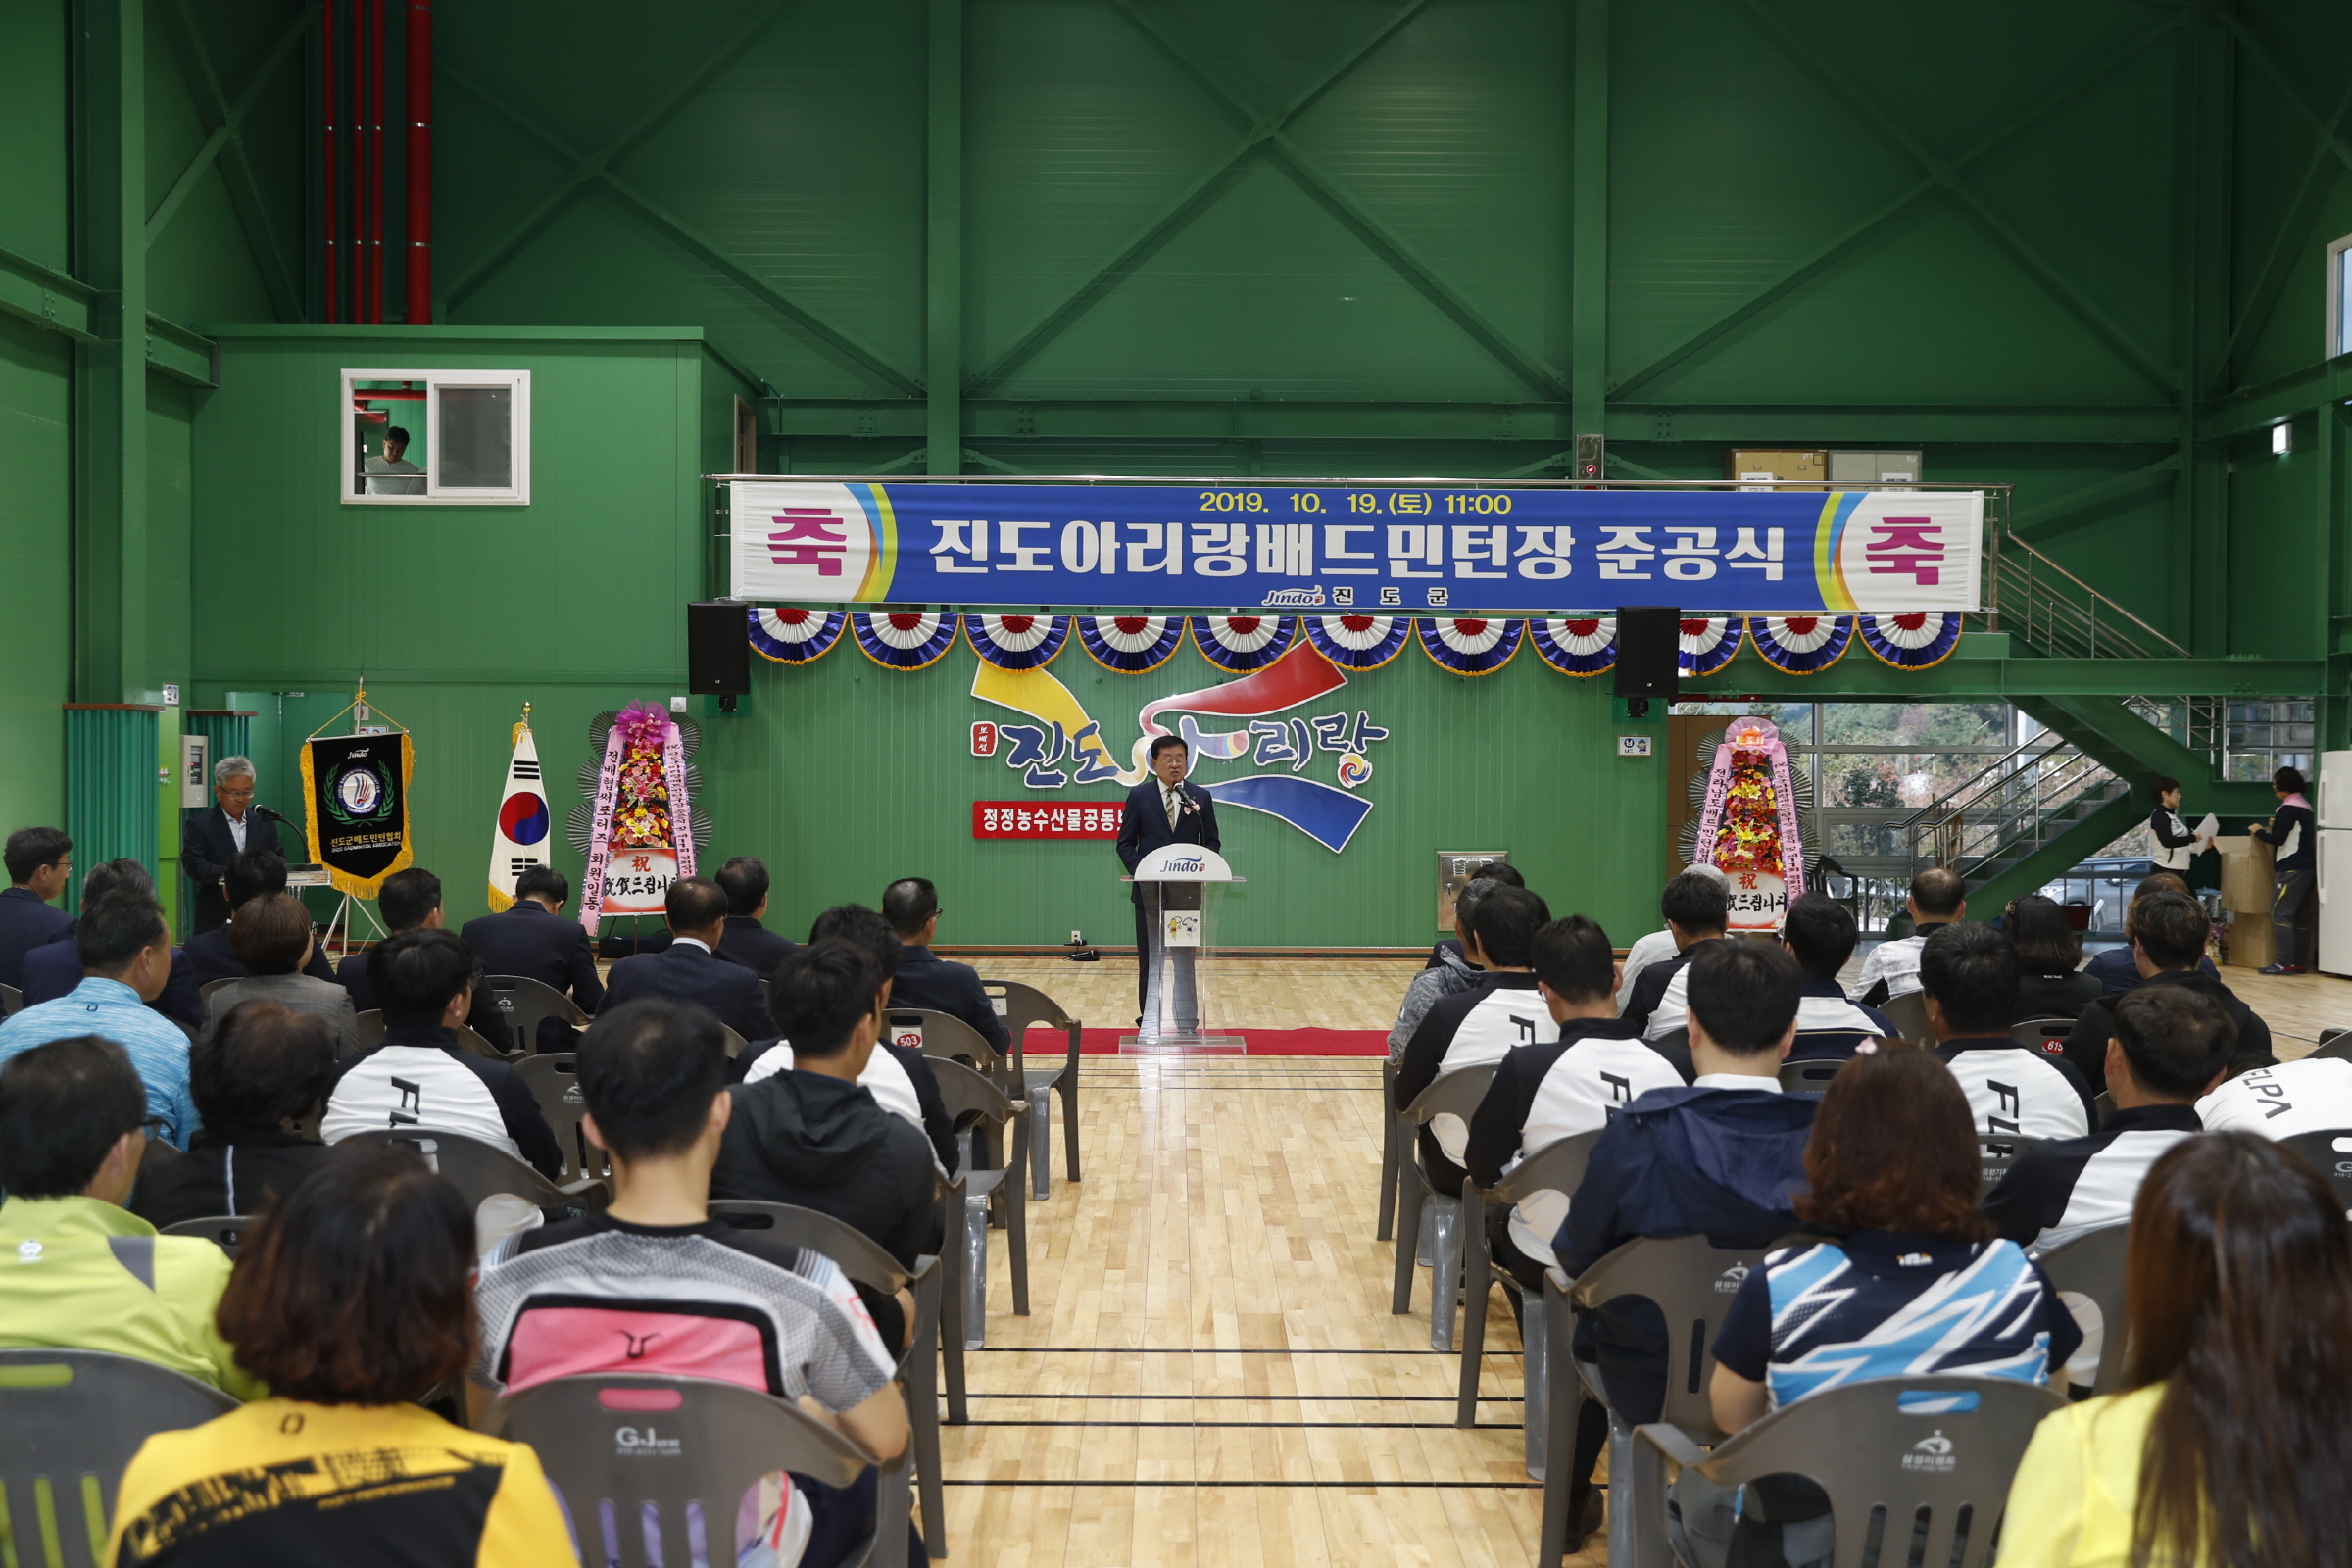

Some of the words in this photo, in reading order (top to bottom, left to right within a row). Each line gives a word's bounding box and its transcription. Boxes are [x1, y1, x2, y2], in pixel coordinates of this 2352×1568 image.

[1199, 491, 1269, 514] 2019.
[1290, 492, 1327, 514] 10.
[1445, 493, 1512, 514] 11:00
[767, 508, 847, 576] 축
[928, 520, 1575, 581] 진도아리랑배드민턴장
[1595, 525, 1785, 582] 준공식
[1865, 516, 1945, 586] 축
[348, 748, 369, 760] Jindo
[983, 808, 1123, 832] 청정농수산물공동
[330, 831, 402, 848] 진도군배드민턴협회
[631, 856, 652, 873] 祝
[1160, 856, 1201, 873] Jindo
[1739, 873, 1758, 890] 祝
[900, 1035, 918, 1047] 503
